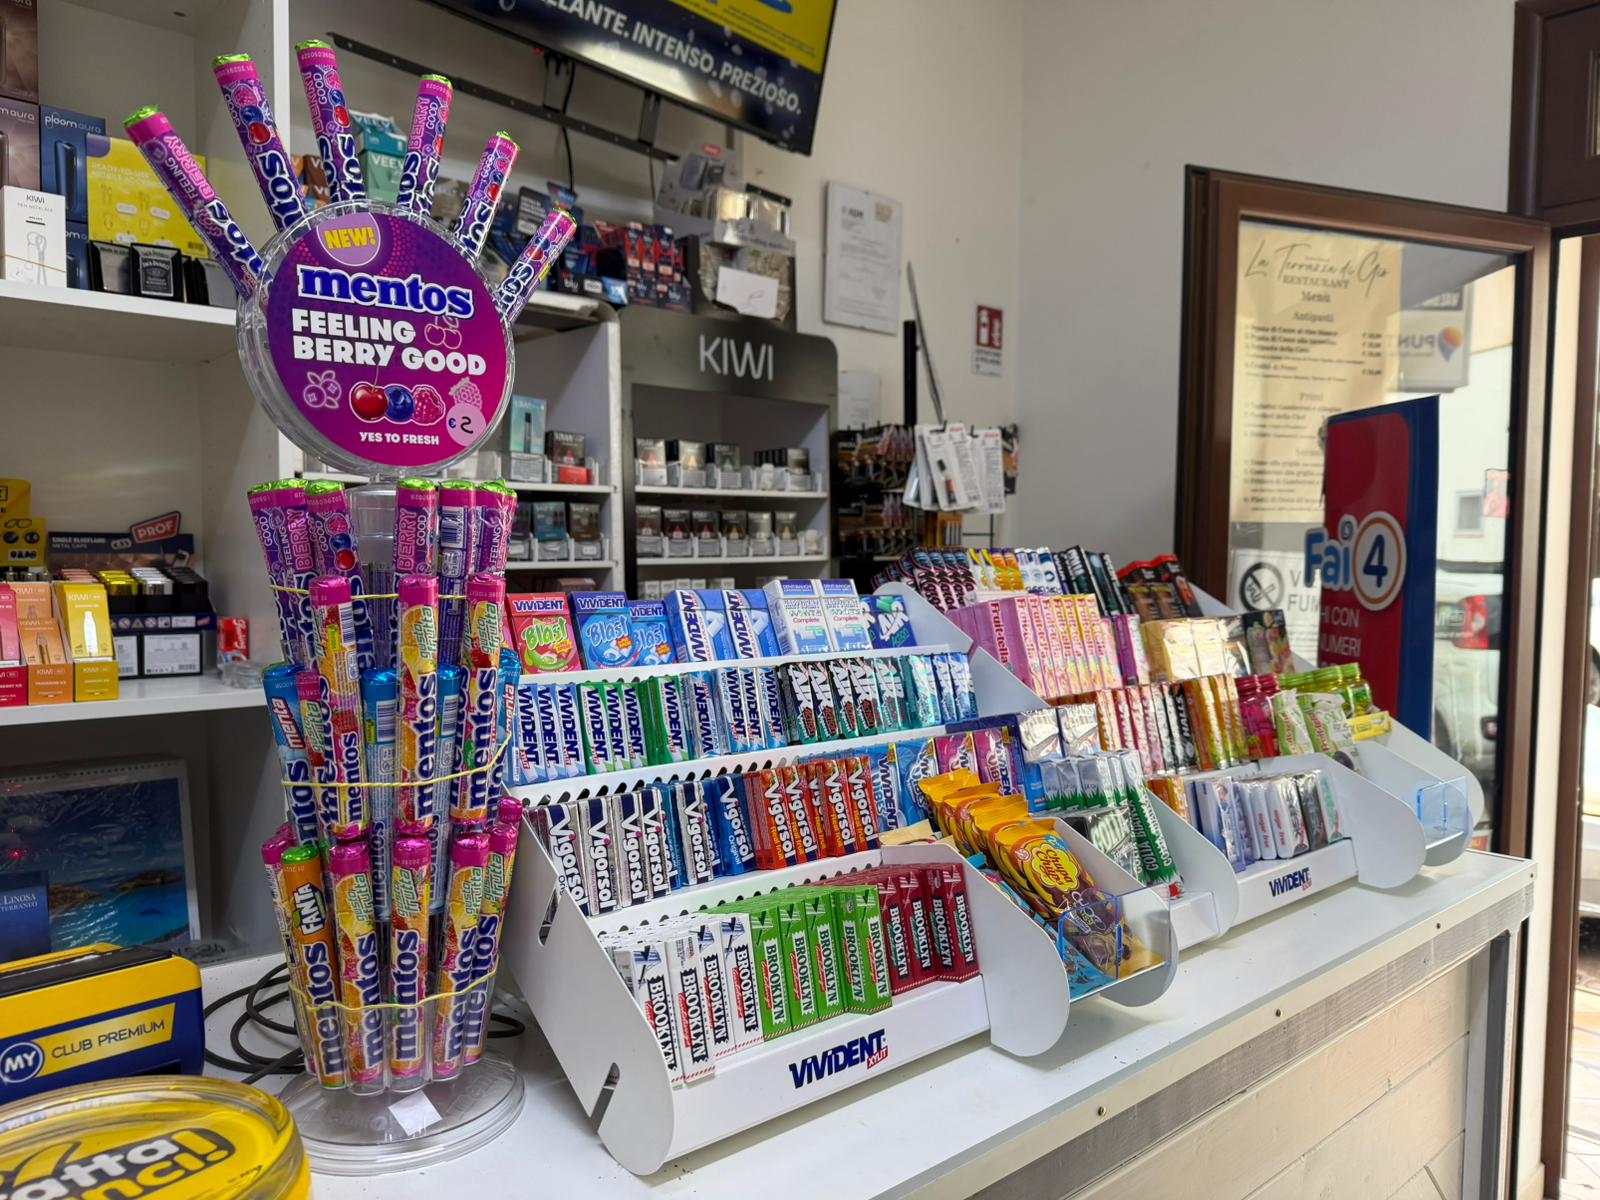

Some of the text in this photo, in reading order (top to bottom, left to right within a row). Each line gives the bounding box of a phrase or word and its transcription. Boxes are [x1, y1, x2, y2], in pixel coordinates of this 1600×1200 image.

[313, 72, 328, 105] GOOD
[632, 20, 718, 77] INTENSO.
[719, 61, 802, 115] PREZIOSO.
[44, 113, 78, 129] ploom
[408, 96, 430, 151] BERRY
[426, 102, 438, 130] GOOD
[165, 157, 198, 199] FEELING
[324, 227, 377, 250] NEW!
[1244, 239, 1269, 278] La
[296, 264, 475, 318] mentos
[1282, 274, 1350, 289] RESTAURANT
[291, 308, 416, 344] FEELING
[293, 336, 487, 376] BERRY GOOD
[700, 334, 774, 381] KIWI
[359, 431, 440, 445] YES TO FRESH
[137, 519, 174, 539] PROF
[260, 516, 273, 547] GOOD
[278, 527, 293, 566] FEELING
[287, 508, 314, 571] BERRY
[315, 520, 329, 552] GOOD
[396, 507, 417, 571] BERRY
[416, 514, 427, 547] GOOD
[1362, 533, 1389, 589] 4
[413, 606, 437, 660] gusto frutta
[477, 603, 498, 655] gusto frutta
[522, 616, 568, 650] Blast
[587, 615, 629, 647] Blast
[272, 697, 305, 750] menta
[503, 683, 516, 737] menta
[1176, 695, 1190, 738] HALLS
[412, 672, 438, 820] mentos
[468, 667, 498, 811] mentos
[341, 731, 363, 822] mentos
[825, 760, 855, 846] Vigorsol
[848, 757, 878, 840] Vigorsol
[684, 782, 711, 879] Vigorsol
[720, 776, 754, 862] Vigorsol
[764, 768, 796, 858] Vigorsol
[786, 766, 817, 854] Vigorsol
[549, 804, 588, 906] Vigorsol
[588, 798, 617, 909] Vigorsol
[621, 793, 648, 899] Vigorsol
[643, 788, 669, 892] Vigorsol
[728, 835, 742, 864] Original
[1036, 849, 1063, 886] Chups
[1045, 848, 1074, 884] Chupa
[1138, 841, 1160, 871] GOLIA
[3, 893, 37, 906] LINOSA
[295, 883, 325, 936] FANTA
[347, 872, 373, 922] gusto frutta
[400, 868, 421, 916] frutta
[464, 867, 483, 915] gusto frutta
[889, 906, 909, 977] BROOKLYN
[912, 900, 931, 968] BROOKLYN
[933, 898, 952, 967] BROOKLYN
[955, 895, 974, 963] BROOKLYN
[464, 914, 499, 1048] mentos
[766, 943, 785, 1021] BROOKLYN
[794, 937, 813, 1013] BROOKLYN
[819, 929, 839, 1005] BROOKLYN
[845, 925, 864, 1000] BROOKLYN
[869, 919, 889, 997] BROOKLYN
[304, 941, 345, 1077] mentos
[355, 931, 384, 1068] mentos
[392, 929, 421, 1061] mentos
[446, 927, 477, 1061] mentos
[682, 971, 706, 1059] BROOKLYN
[705, 958, 728, 1042] BROOKLYN
[737, 948, 757, 1030] BROOKLYN
[4, 1019, 166, 1074] MY CLUB PREMIUM
[650, 979, 676, 1069] BROOKLYN
[867, 1046, 888, 1069] XYLIT
